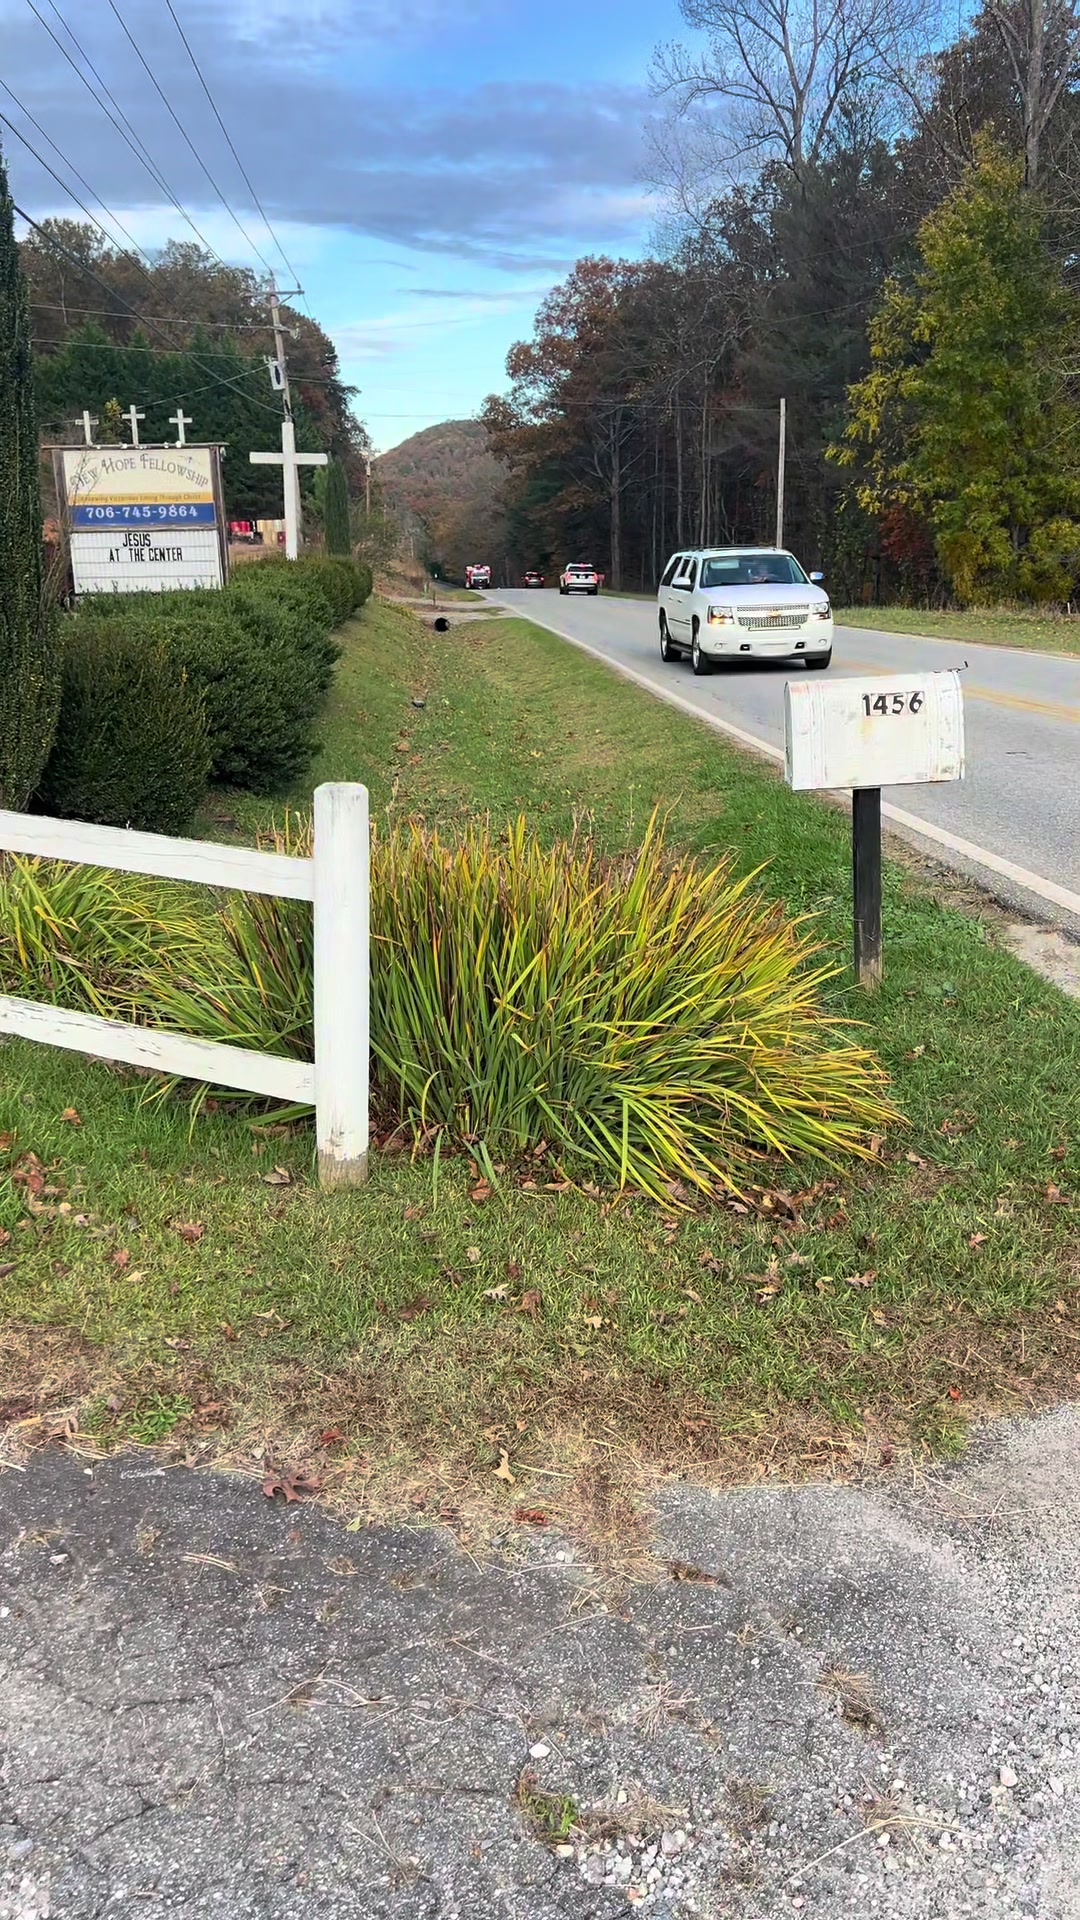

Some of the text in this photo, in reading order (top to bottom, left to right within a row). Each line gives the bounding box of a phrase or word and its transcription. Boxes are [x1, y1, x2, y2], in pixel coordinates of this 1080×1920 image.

[101, 457, 136, 474] HOPE
[140, 453, 209, 487] FELLOWSHIP
[86, 505, 198, 519] 706-745-9864
[122, 533, 151, 547] JESUS
[109, 547, 183, 562] AT THE CENTER
[862, 692, 923, 716] 1456
